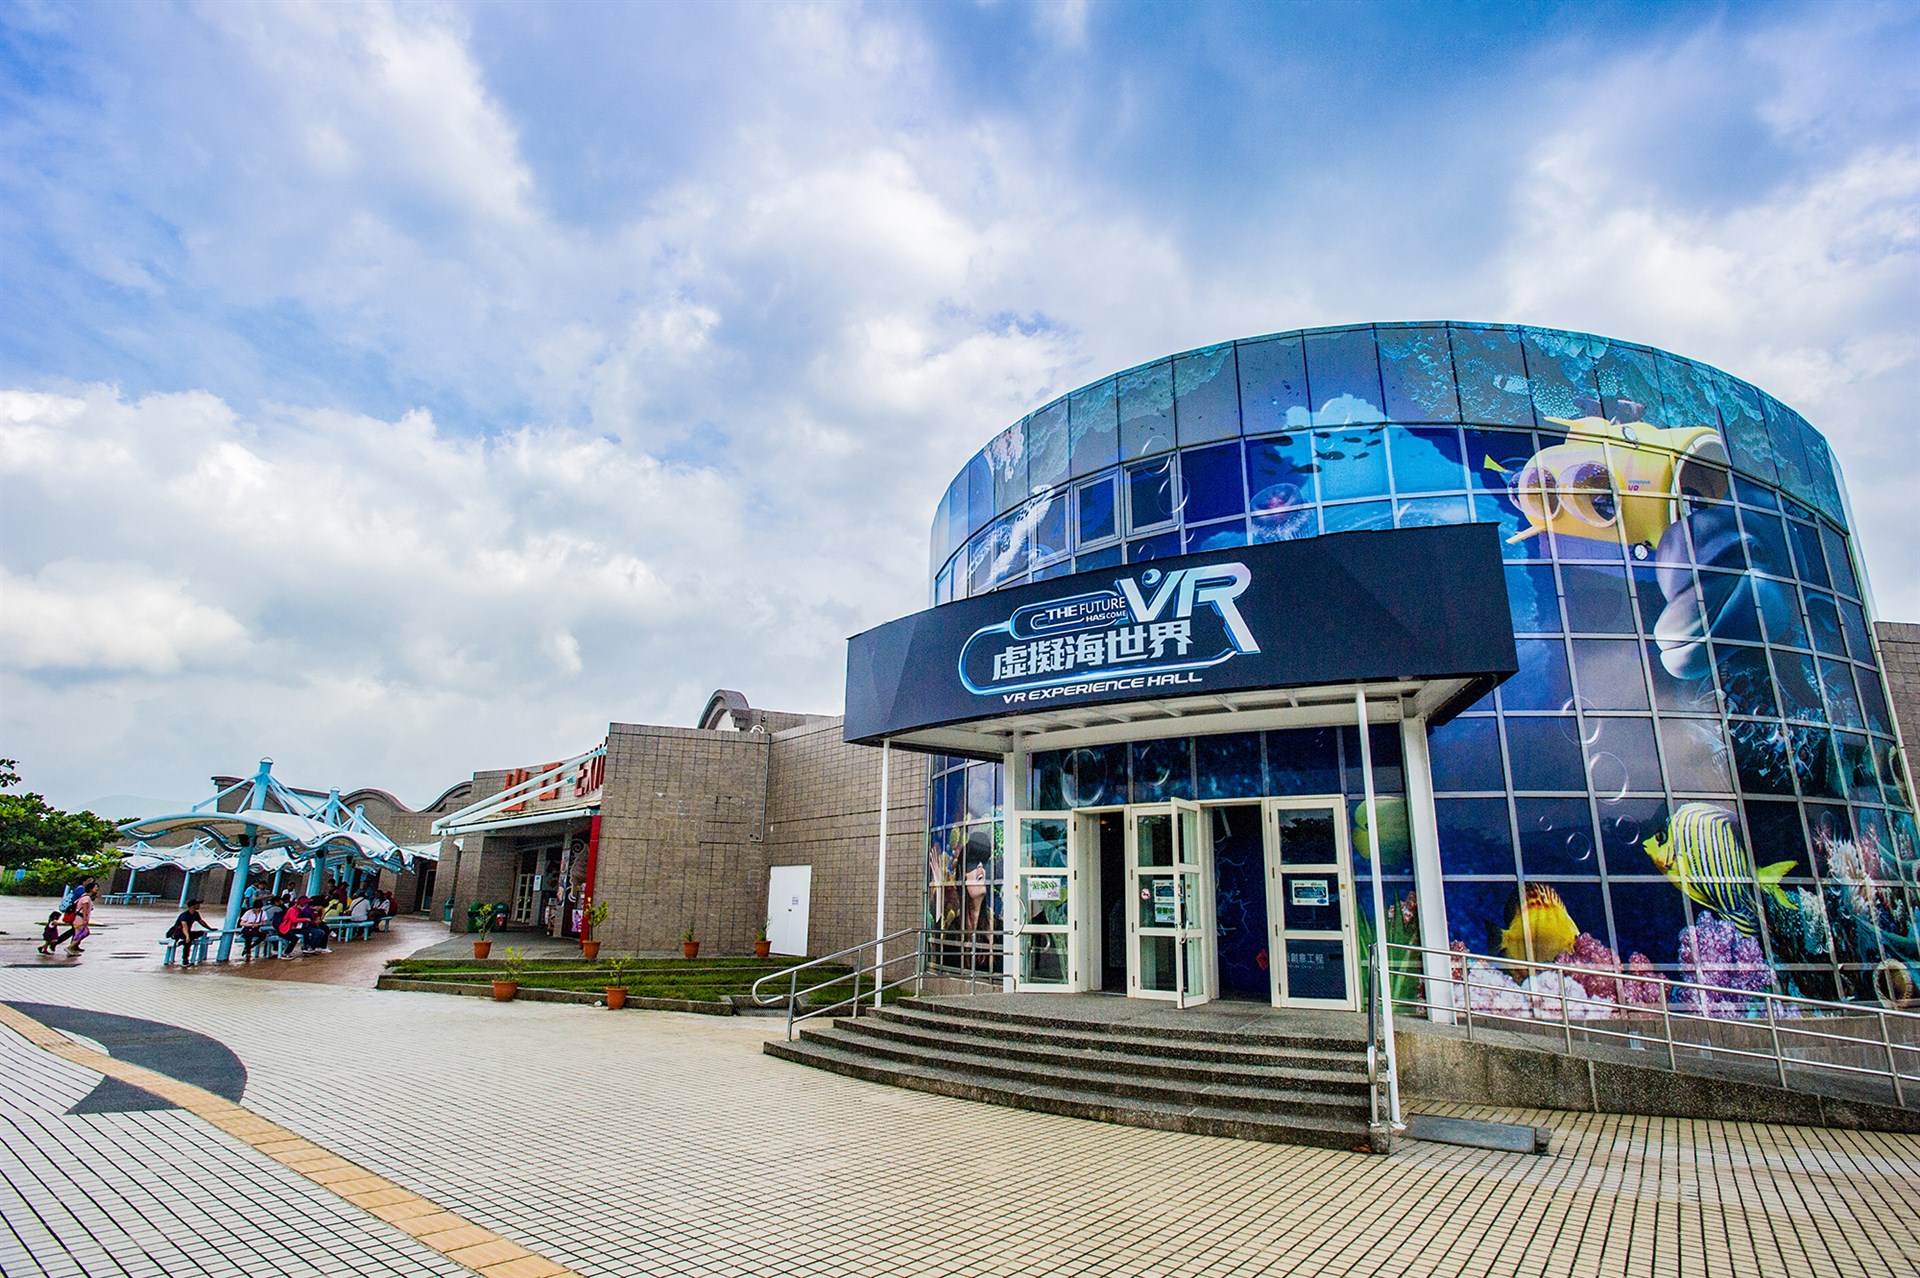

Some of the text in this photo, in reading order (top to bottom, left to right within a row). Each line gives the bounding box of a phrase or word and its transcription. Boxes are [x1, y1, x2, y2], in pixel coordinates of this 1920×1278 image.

[1045, 596, 1126, 620] THE FUTURE
[1086, 609, 1126, 623] HAS COME
[1116, 562, 1261, 655] VR
[992, 619, 1194, 681] 虛擬海世界
[1002, 672, 1203, 705] VR EXPERIENCE HALL
